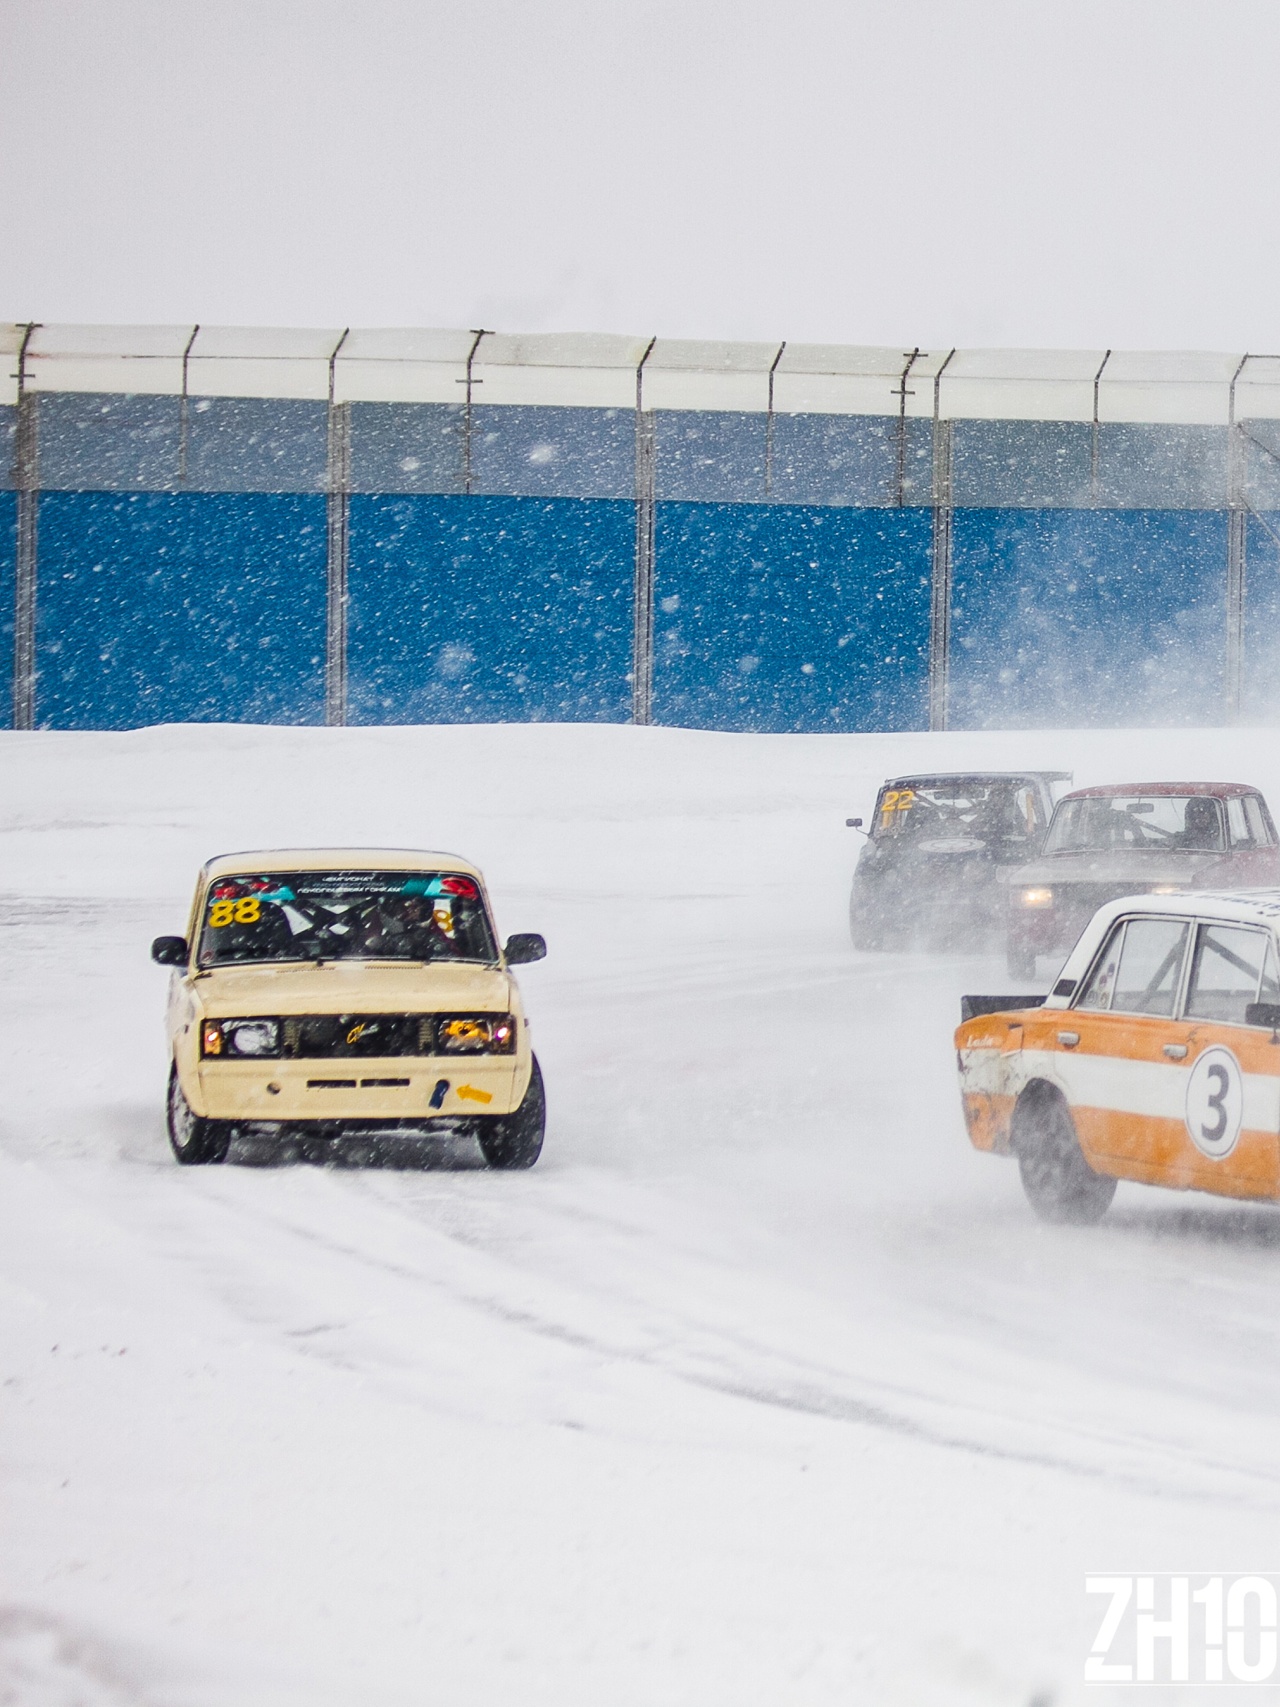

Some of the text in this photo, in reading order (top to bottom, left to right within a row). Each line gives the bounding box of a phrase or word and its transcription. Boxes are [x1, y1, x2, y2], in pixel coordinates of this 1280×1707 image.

[880, 791, 914, 812] 22
[208, 896, 262, 929] 88
[1200, 1063, 1231, 1142] 3
